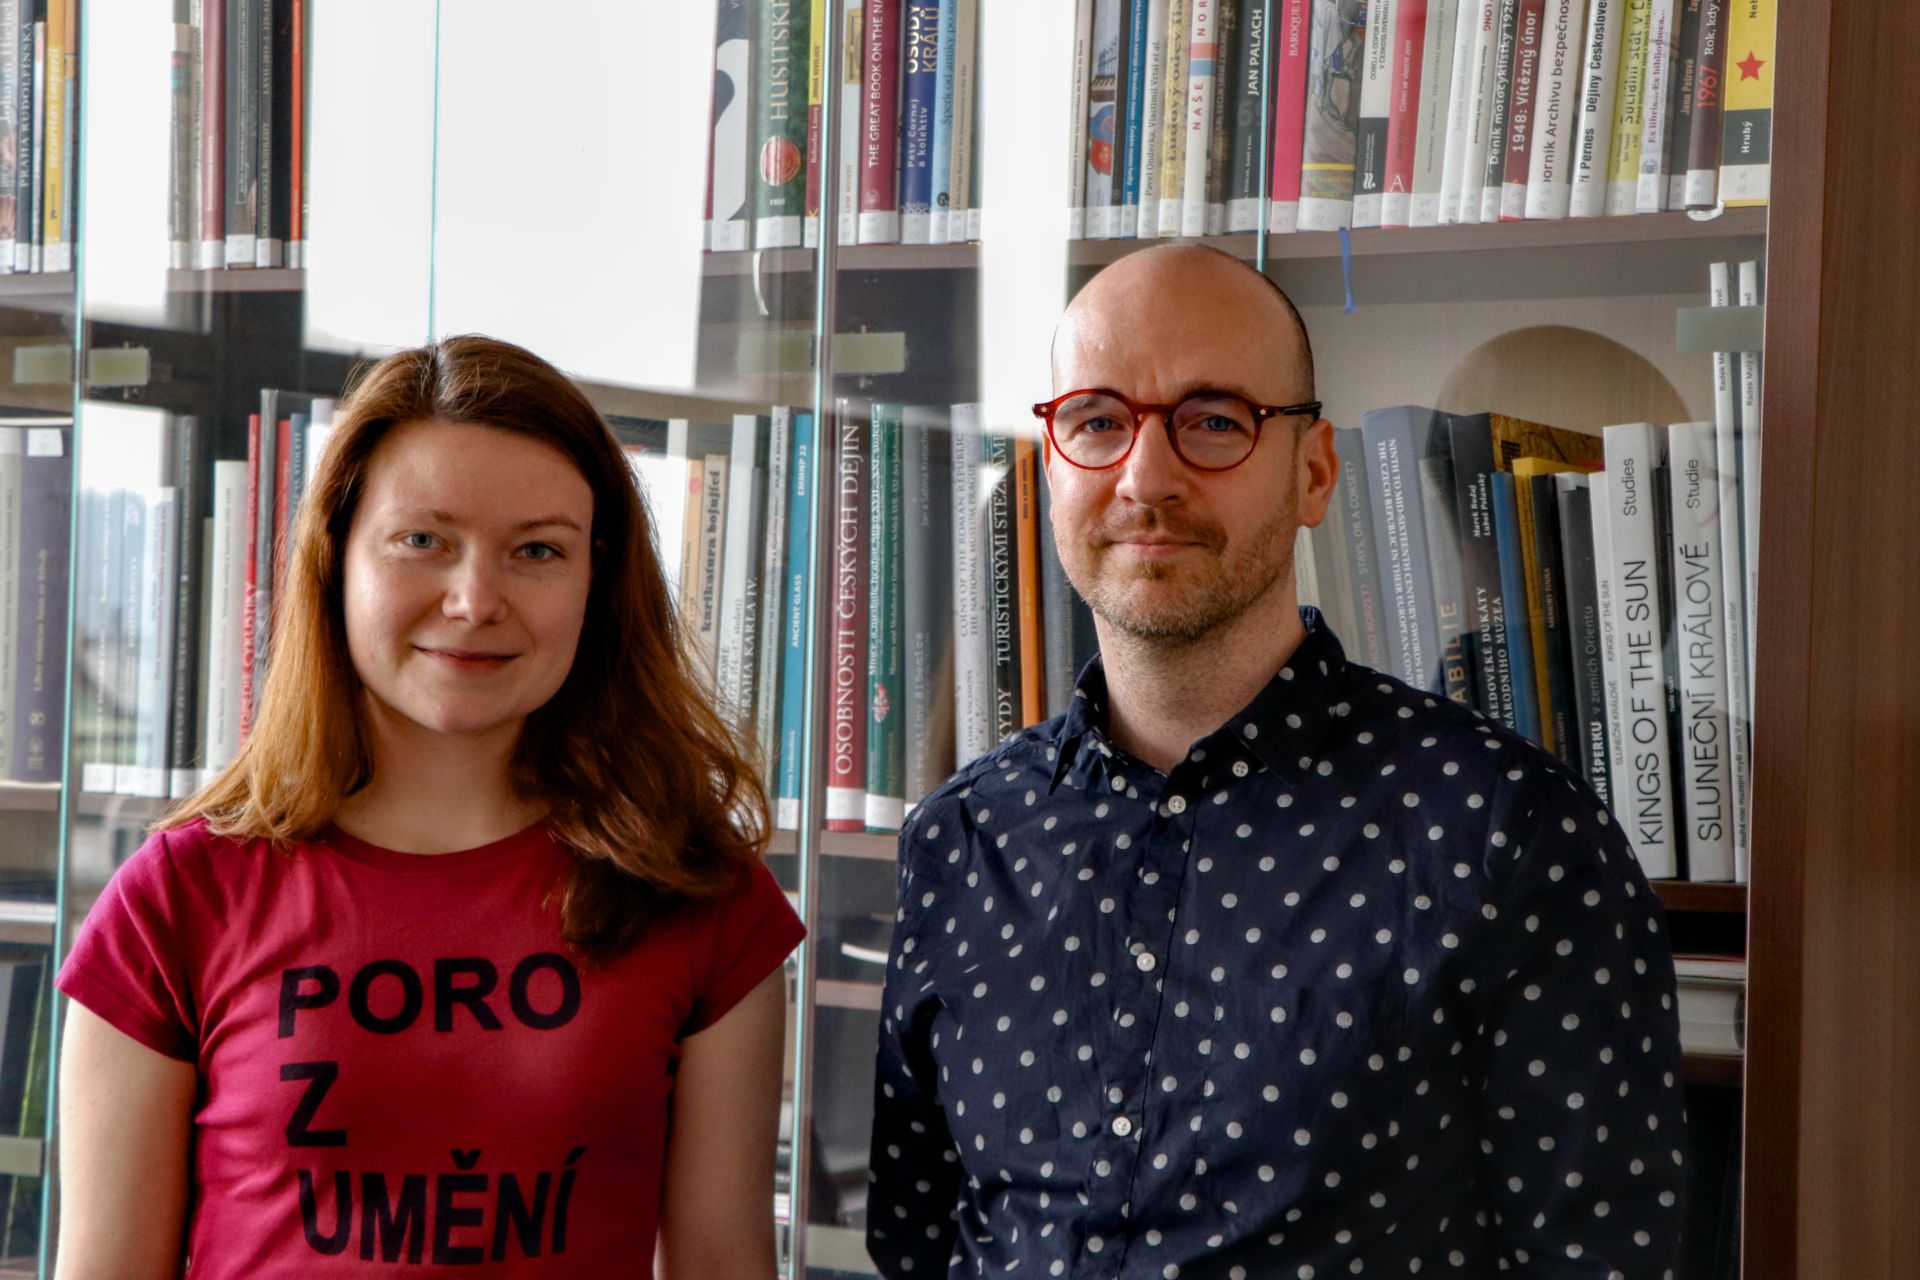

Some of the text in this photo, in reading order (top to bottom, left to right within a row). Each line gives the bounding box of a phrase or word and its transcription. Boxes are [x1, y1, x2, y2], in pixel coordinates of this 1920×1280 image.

[907, 5, 920, 73] OSUDY
[920, 7, 938, 72] KRÁLŮ
[1152, 40, 1160, 51] al.
[1289, 7, 1302, 56] BAROQUE
[1379, 1, 1389, 63] ČESKOSLOVENSKU
[1483, 4, 1492, 31] LONG
[1628, 31, 1641, 60] stát
[1150, 65, 1158, 86] Vrtal
[1248, 9, 1262, 96] JAN PALACH
[1370, 57, 1378, 80] ODBOJ
[1494, 32, 1513, 124] motocyklistky
[1696, 4, 1720, 108] 1967 Rok, kdy
[20, 22, 32, 188] PRAHA RUDOLFÍNSKÁ
[48, 48, 61, 168] securitas imperii
[869, 17, 883, 168] THE GREAT BOOK ON THE
[943, 77, 952, 89] od
[1148, 88, 1158, 127] Vlastimil
[1192, 84, 1203, 130] NAŠE
[1512, 10, 1536, 152] 1948: Vítězný únor
[1546, 81, 1562, 136] Archivu
[1580, 0, 1607, 168] Pernes Dějiny Českoslove
[1620, 66, 1638, 124] Sociální
[1681, 59, 1694, 115] Jana Petrová
[918, 107, 928, 156] kolektiv
[1648, 132, 1656, 143] Ex
[1652, 78, 1660, 90] Ex
[1741, 121, 1753, 153] Hrubý
[907, 143, 916, 167] Petr
[1146, 130, 1156, 170] Onderka,
[1489, 129, 1501, 164] Deník
[1145, 172, 1154, 195] Pavel
[1718, 369, 1727, 391] Radek
[1746, 360, 1755, 406] Radek Malý
[797, 445, 807, 496] EMMNP 22
[992, 435, 1008, 529] STEZAMI
[1388, 439, 1399, 474] NINTH
[1392, 476, 1401, 489] TO
[920, 473, 929, 502] Sabina
[1469, 485, 1480, 537] Marek Budaj
[1477, 473, 1488, 510] Polanský
[920, 512, 929, 527] Jan
[956, 433, 967, 637] COINS OF THE ROMAN REPUBLIC
[1377, 440, 1410, 651] THE CZECH REPUBLIC IN THEIR EUROPEAN
[1394, 491, 1411, 571] MID-SIXTEENTH
[700, 470, 720, 632] karikatura bojující
[967, 463, 979, 635] THE NATIONAL MUSEUM PRAGUE
[1345, 461, 1378, 664] NEBO KORZET? STAYS, OR A CORSET?
[834, 425, 864, 774] OSOBNOSTI ČESKÝCH DĚJIN
[992, 533, 1011, 665] TURISTICKÝMI
[1405, 573, 1417, 621] CENTURY
[1544, 568, 1552, 591] TOOLS
[792, 574, 802, 647] ANCIENT GLASS
[1476, 586, 1493, 642] DUKÁTY
[1584, 605, 1597, 654] Orientu
[740, 577, 758, 718] PRAHA KARLA IV.
[1409, 622, 1422, 667] SWORDS
[1440, 603, 1467, 704] ABILIE
[1493, 596, 1515, 729] NÁRODNÍHO MUZEA
[1621, 458, 1664, 845] KINGS OF THE SUN Studies
[1679, 459, 1723, 842] SLUNEČNÍ KRÁLOVÉ Studie
[1587, 658, 1601, 704] zemích
[1601, 580, 1624, 766] SLUNEČNÍ KRÁLOVÉ KINGS OF THE SUN
[1590, 721, 1606, 774] ŠPERKU
[1735, 755, 1745, 773] myši
[1736, 775, 1746, 805] muzejní
[278, 952, 582, 1039] PORO
[280, 1060, 347, 1147] Z
[296, 1146, 589, 1266] UMĚNÍ
